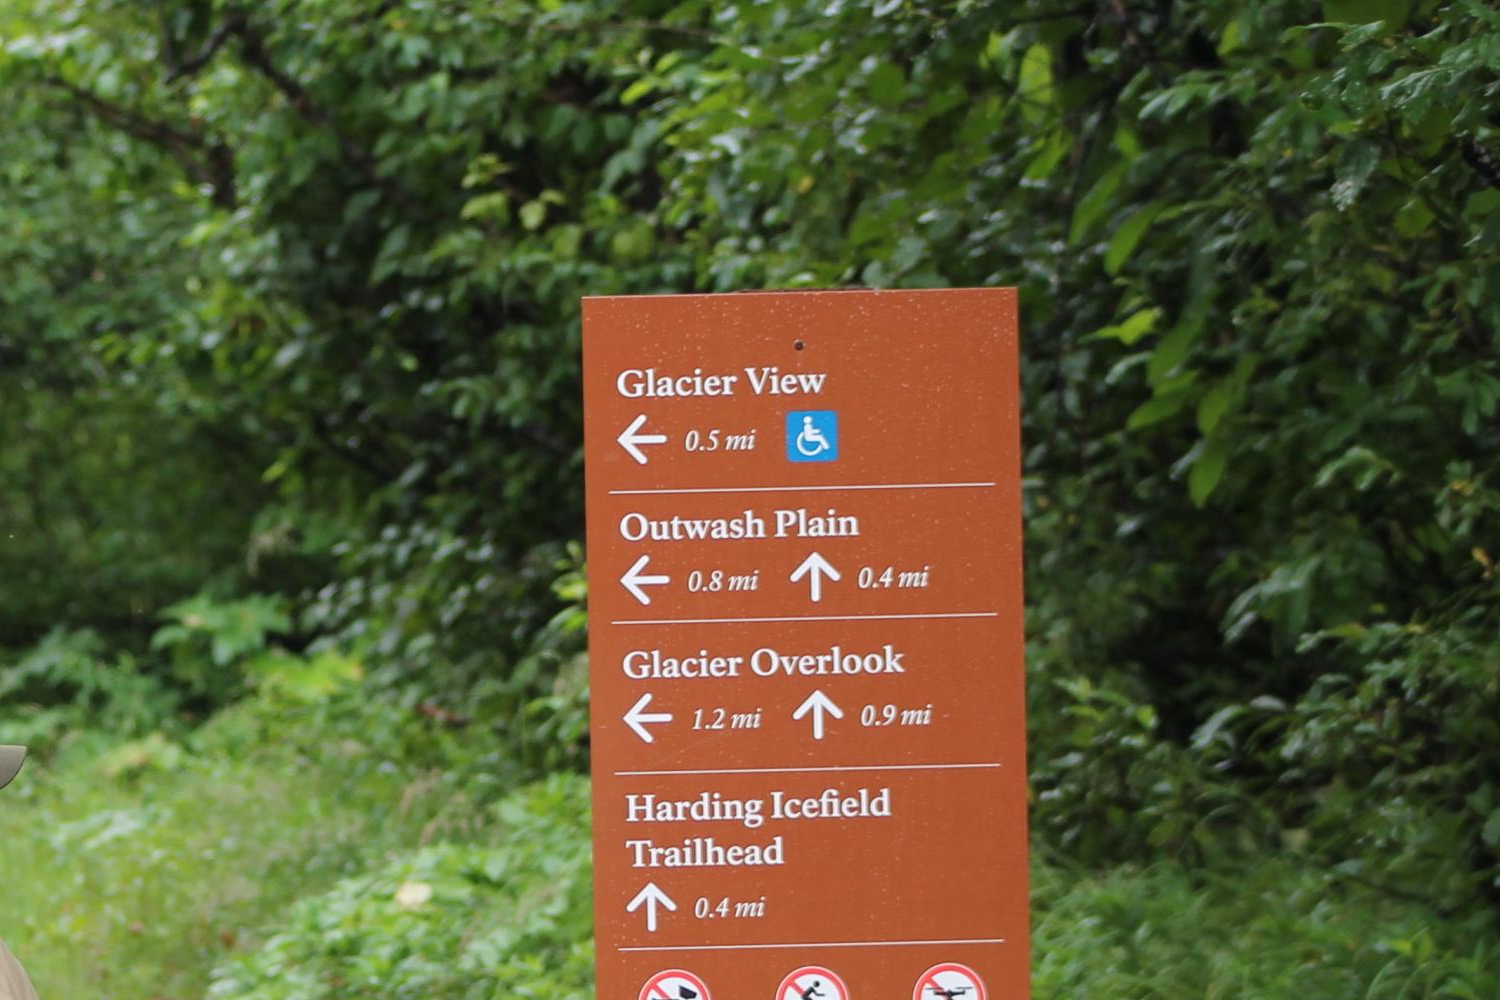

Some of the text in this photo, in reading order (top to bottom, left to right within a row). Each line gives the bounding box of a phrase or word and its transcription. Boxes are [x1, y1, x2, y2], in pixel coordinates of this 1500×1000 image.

[616, 366, 827, 398] Glacier View
[684, 428, 757, 452] 0.5 mi
[619, 508, 860, 541] Outwash Plain
[687, 568, 759, 593] 0.8 mi
[857, 564, 930, 589] 0.4 mi
[622, 644, 905, 680] Glacier Overlook
[691, 706, 763, 730] 1.2 mi
[860, 702, 933, 727] 0.9 mi
[625, 787, 892, 828] Harding Icefield
[625, 835, 785, 868] Trailhead
[693, 895, 766, 919] 0.4 mi
